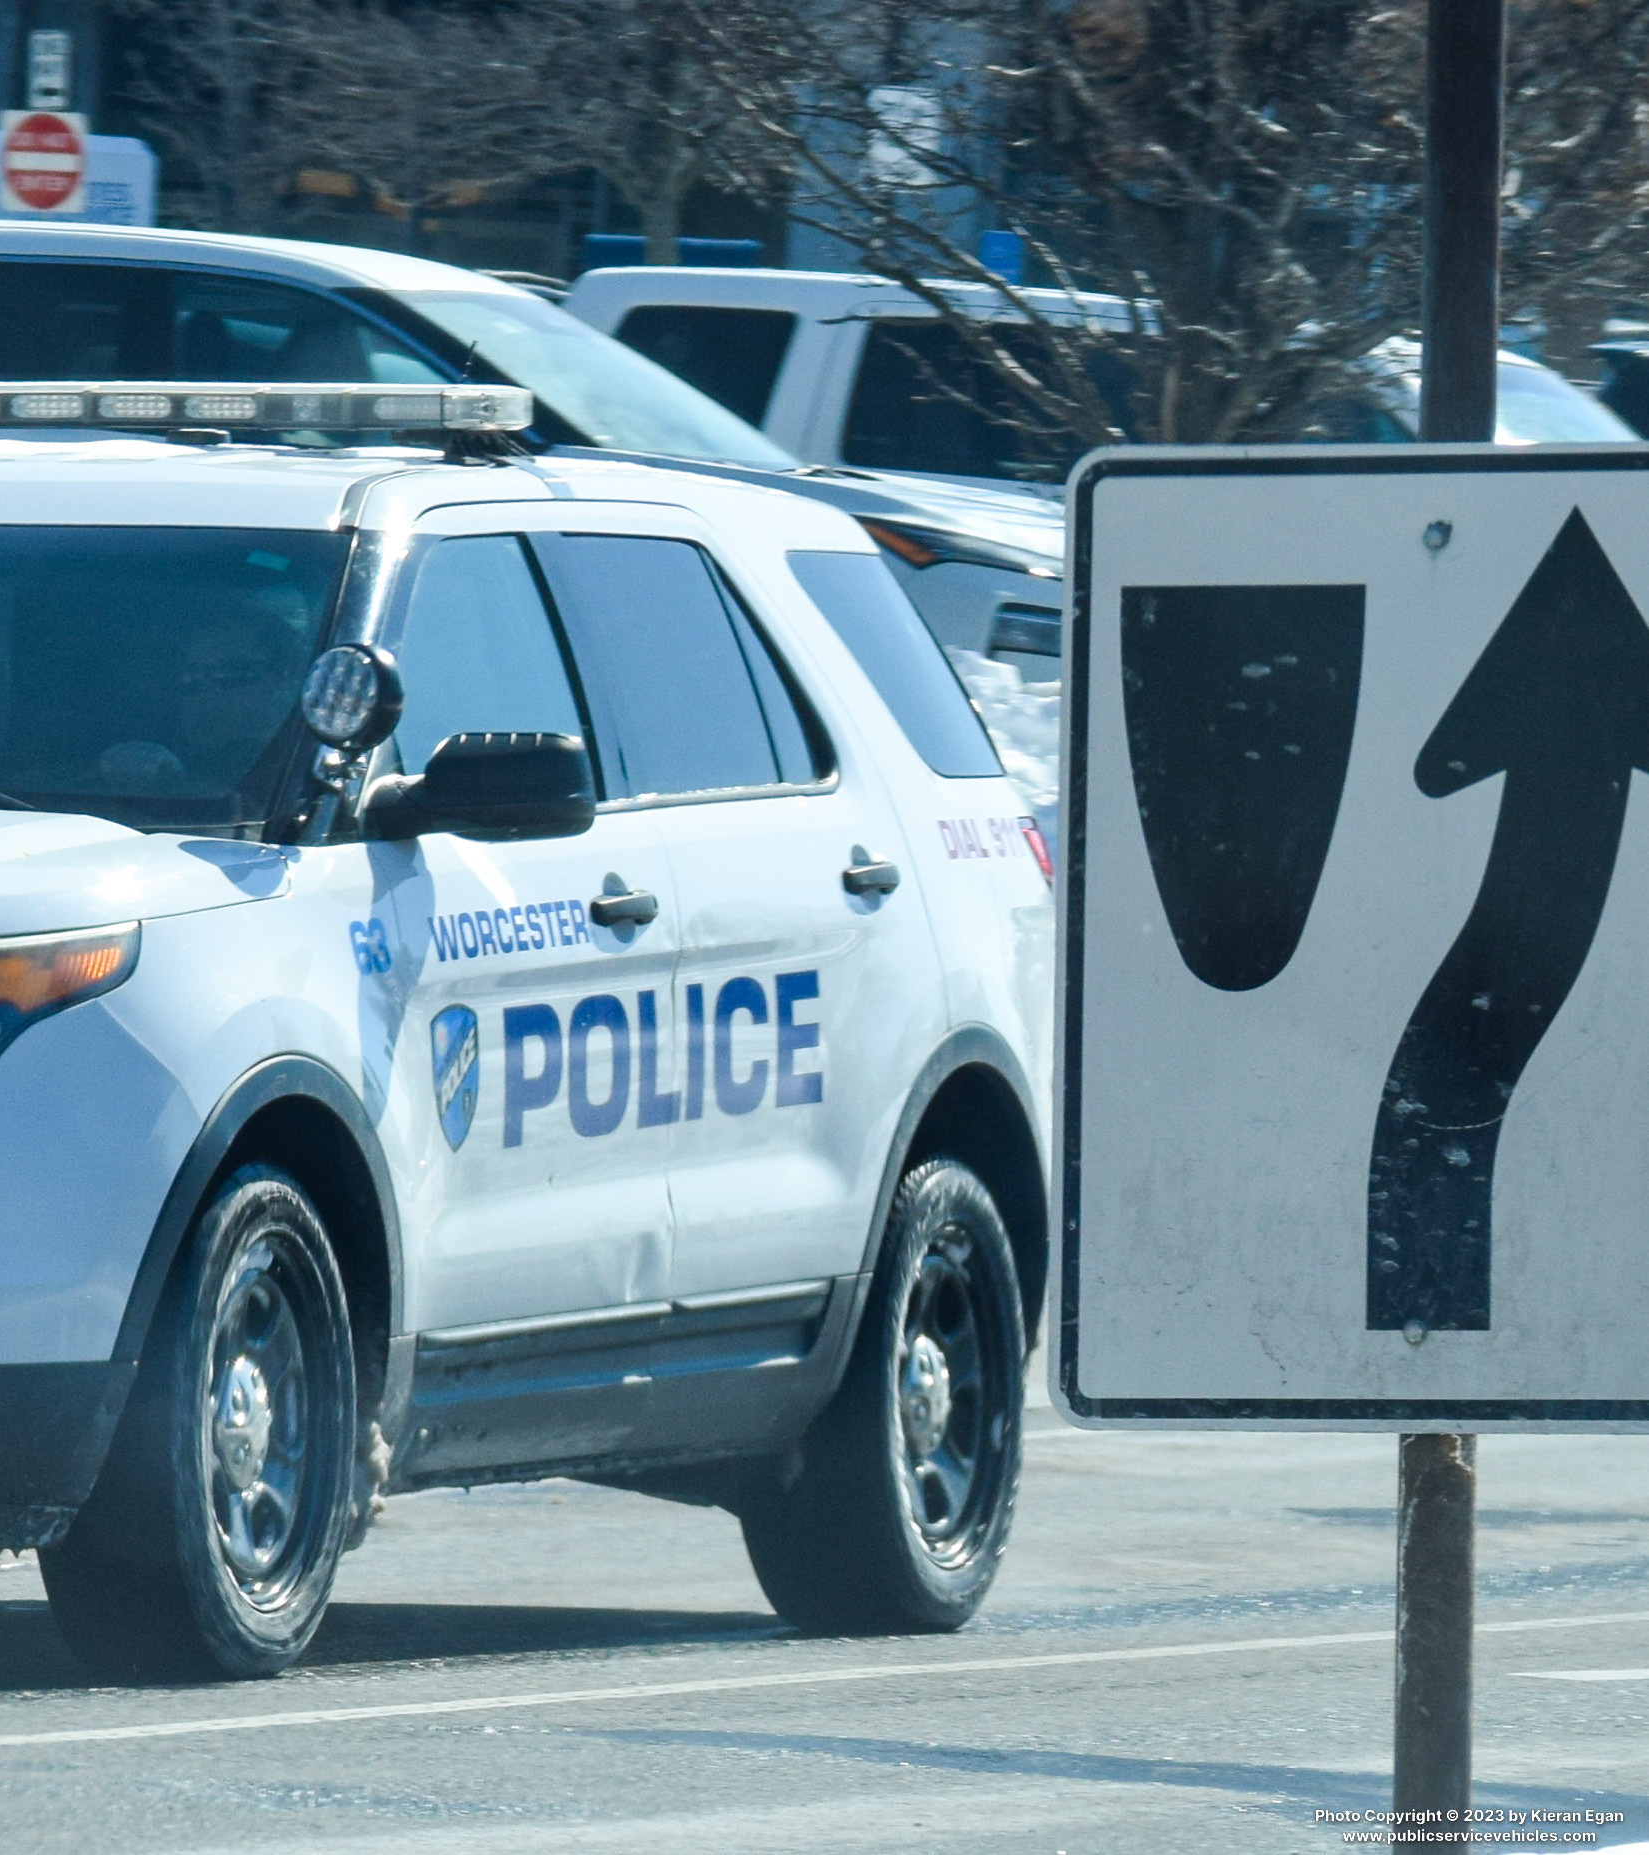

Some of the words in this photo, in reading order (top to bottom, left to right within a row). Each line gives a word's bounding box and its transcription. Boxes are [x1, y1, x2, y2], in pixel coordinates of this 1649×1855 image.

[937, 819, 990, 859] DIAL
[348, 917, 392, 976] 63
[428, 900, 590, 963] WORCESTER
[502, 969, 824, 1150] POLICE
